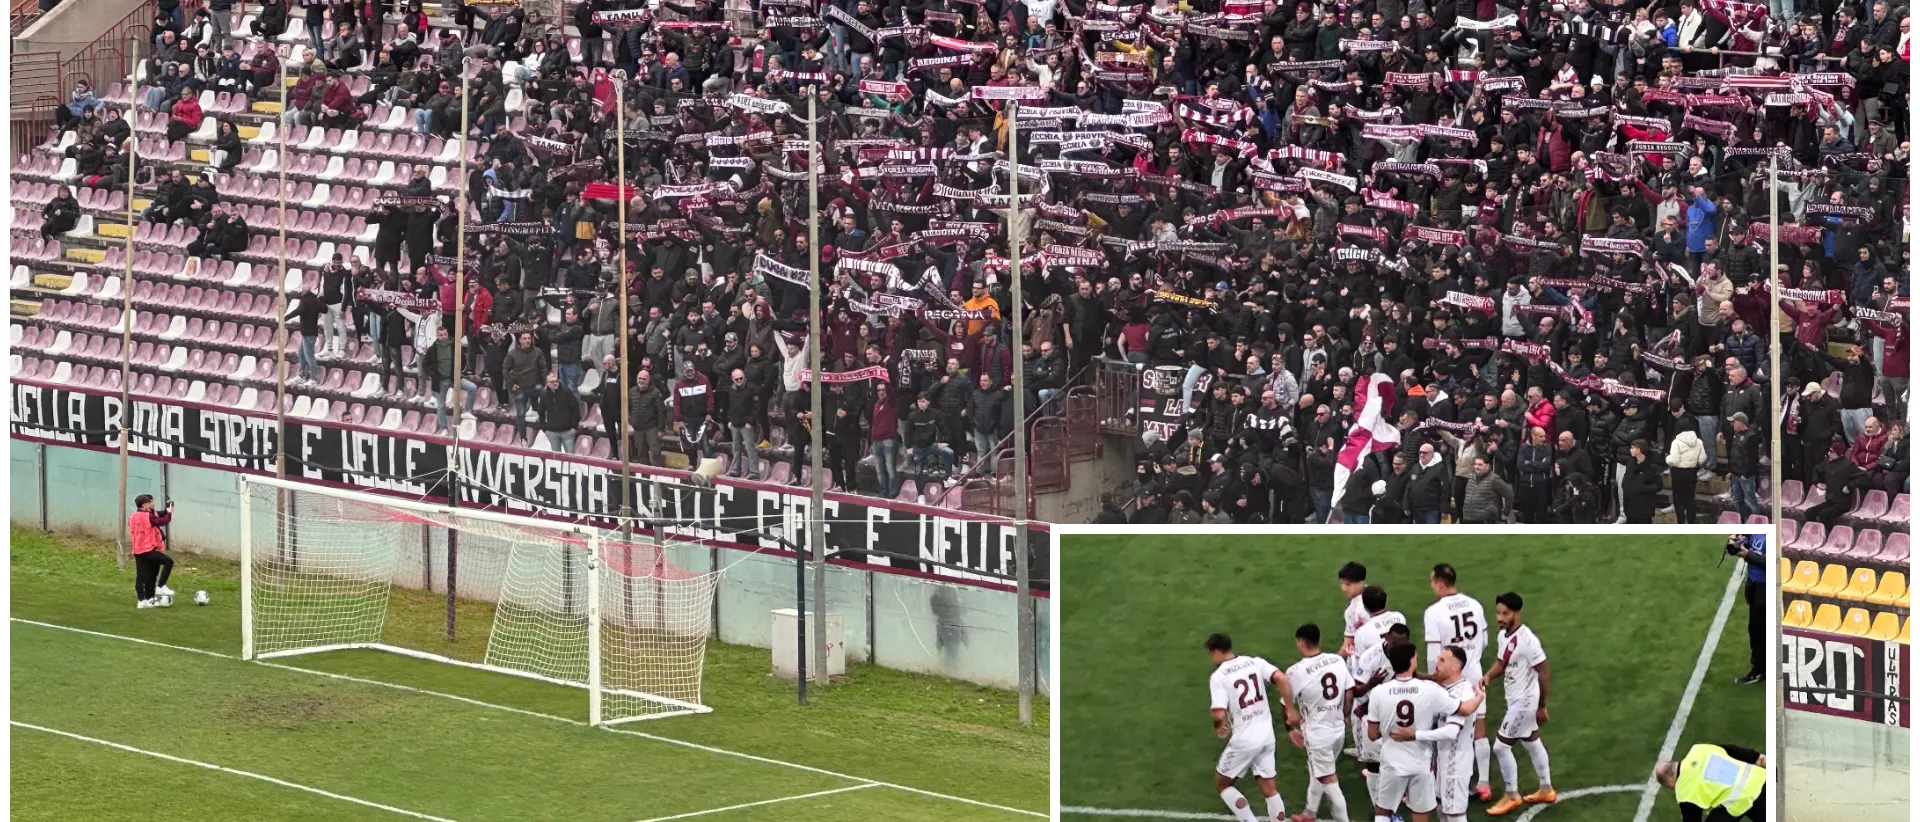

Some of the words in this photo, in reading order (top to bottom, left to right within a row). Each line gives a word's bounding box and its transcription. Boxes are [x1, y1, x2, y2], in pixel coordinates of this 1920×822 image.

[917, 55, 958, 67] REGGINA
[907, 167, 934, 175] REGGINA
[872, 199, 940, 214] WARRIORS
[1062, 205, 1081, 217] SUD
[921, 229, 966, 238] REGGINA
[416, 298, 429, 308] 1914
[925, 310, 985, 320] REGGINA
[10, 383, 88, 444] NELLA
[199, 409, 279, 473] SORTE
[302, 424, 323, 480] E
[342, 429, 426, 496] NELLE
[634, 471, 737, 542] NELLE
[756, 490, 840, 559] GIOE
[866, 505, 891, 567] E
[918, 513, 1018, 587] NELLE
[1450, 611, 1478, 643] 15
[1233, 672, 1264, 710] 21
[1320, 672, 1339, 701] 8
[1886, 647, 1899, 726] ULTRAS
[1396, 699, 1415, 728] 9
